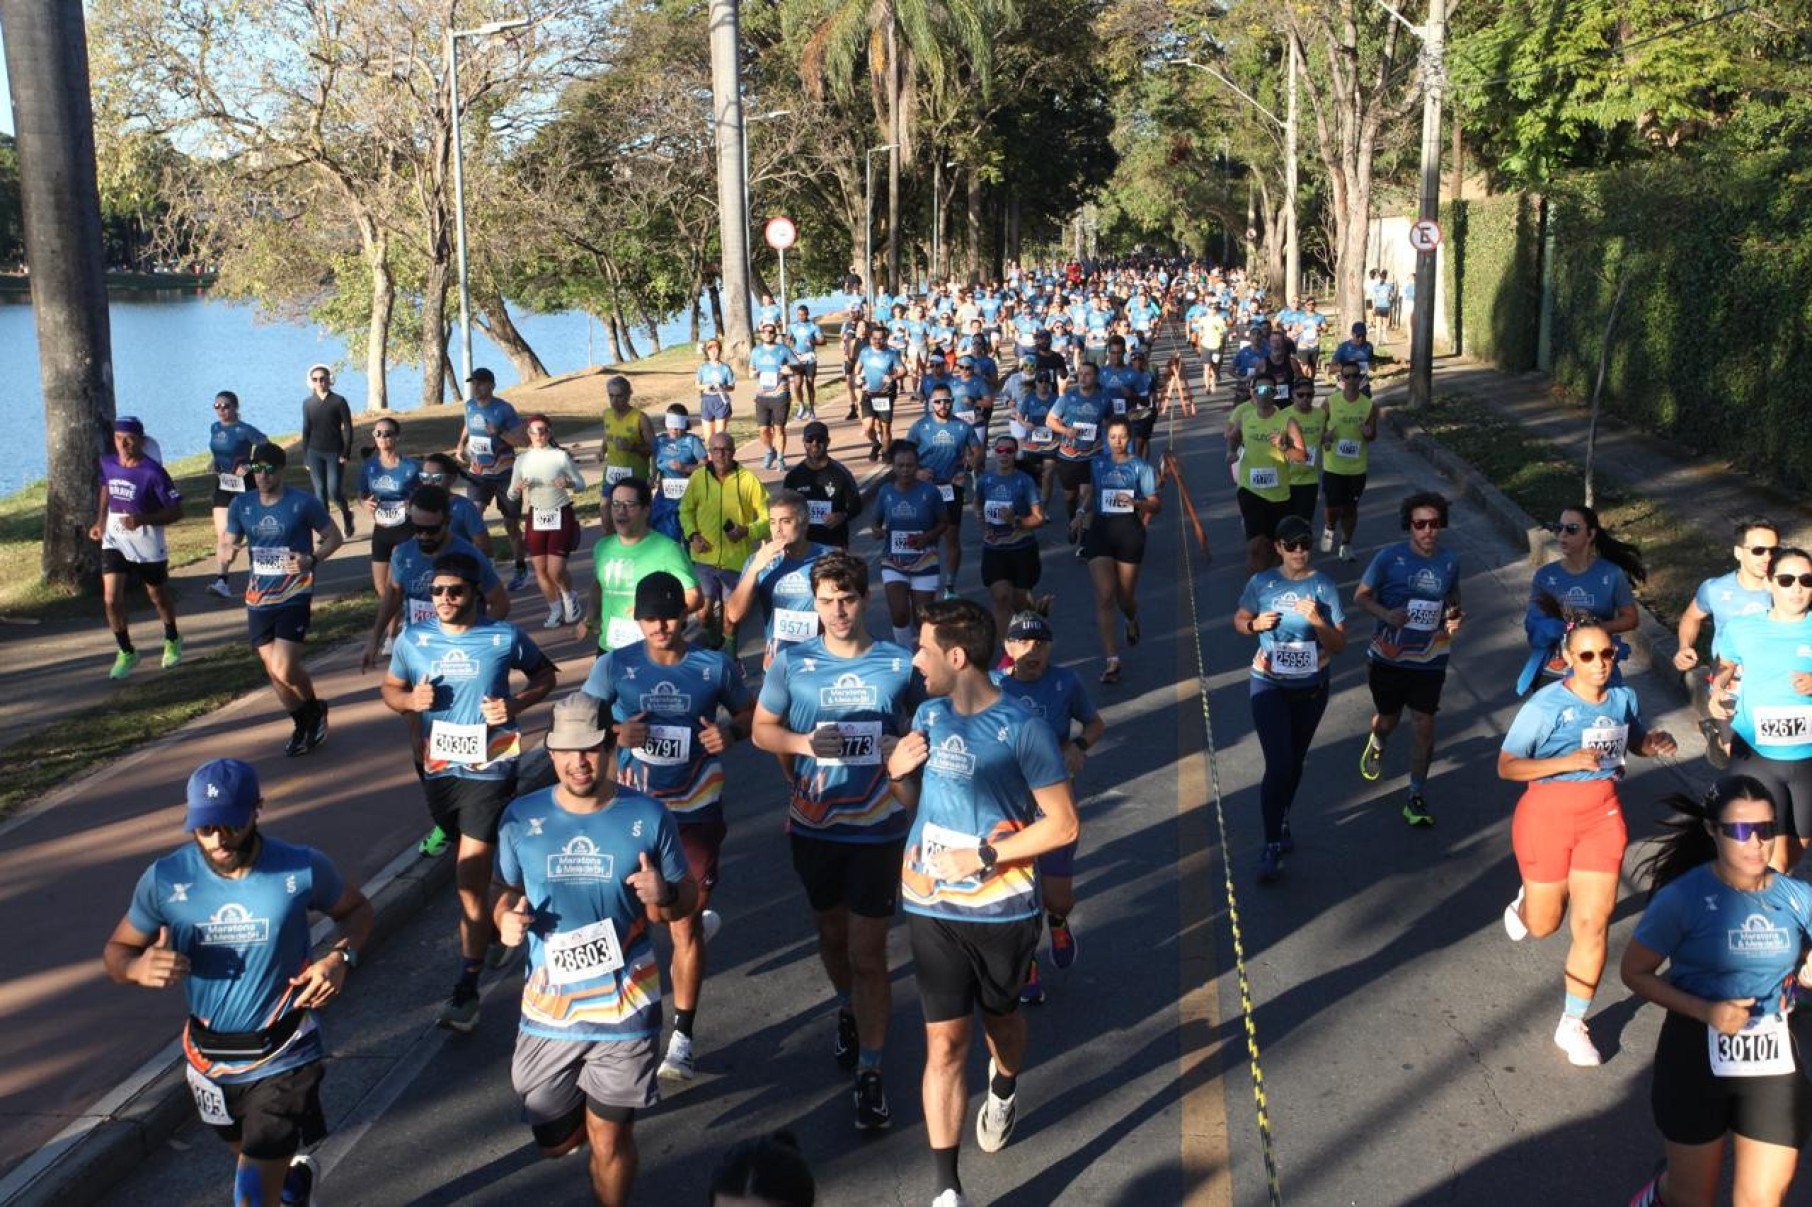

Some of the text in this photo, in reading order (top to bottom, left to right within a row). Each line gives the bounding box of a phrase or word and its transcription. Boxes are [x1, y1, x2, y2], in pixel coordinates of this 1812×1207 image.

[779, 618, 810, 636] 9571
[1761, 717, 1807, 737] 32612
[435, 733, 478, 754] 30306
[840, 736, 873, 757] 773
[553, 938, 611, 972] 28603
[1718, 1033, 1779, 1062] 30107
